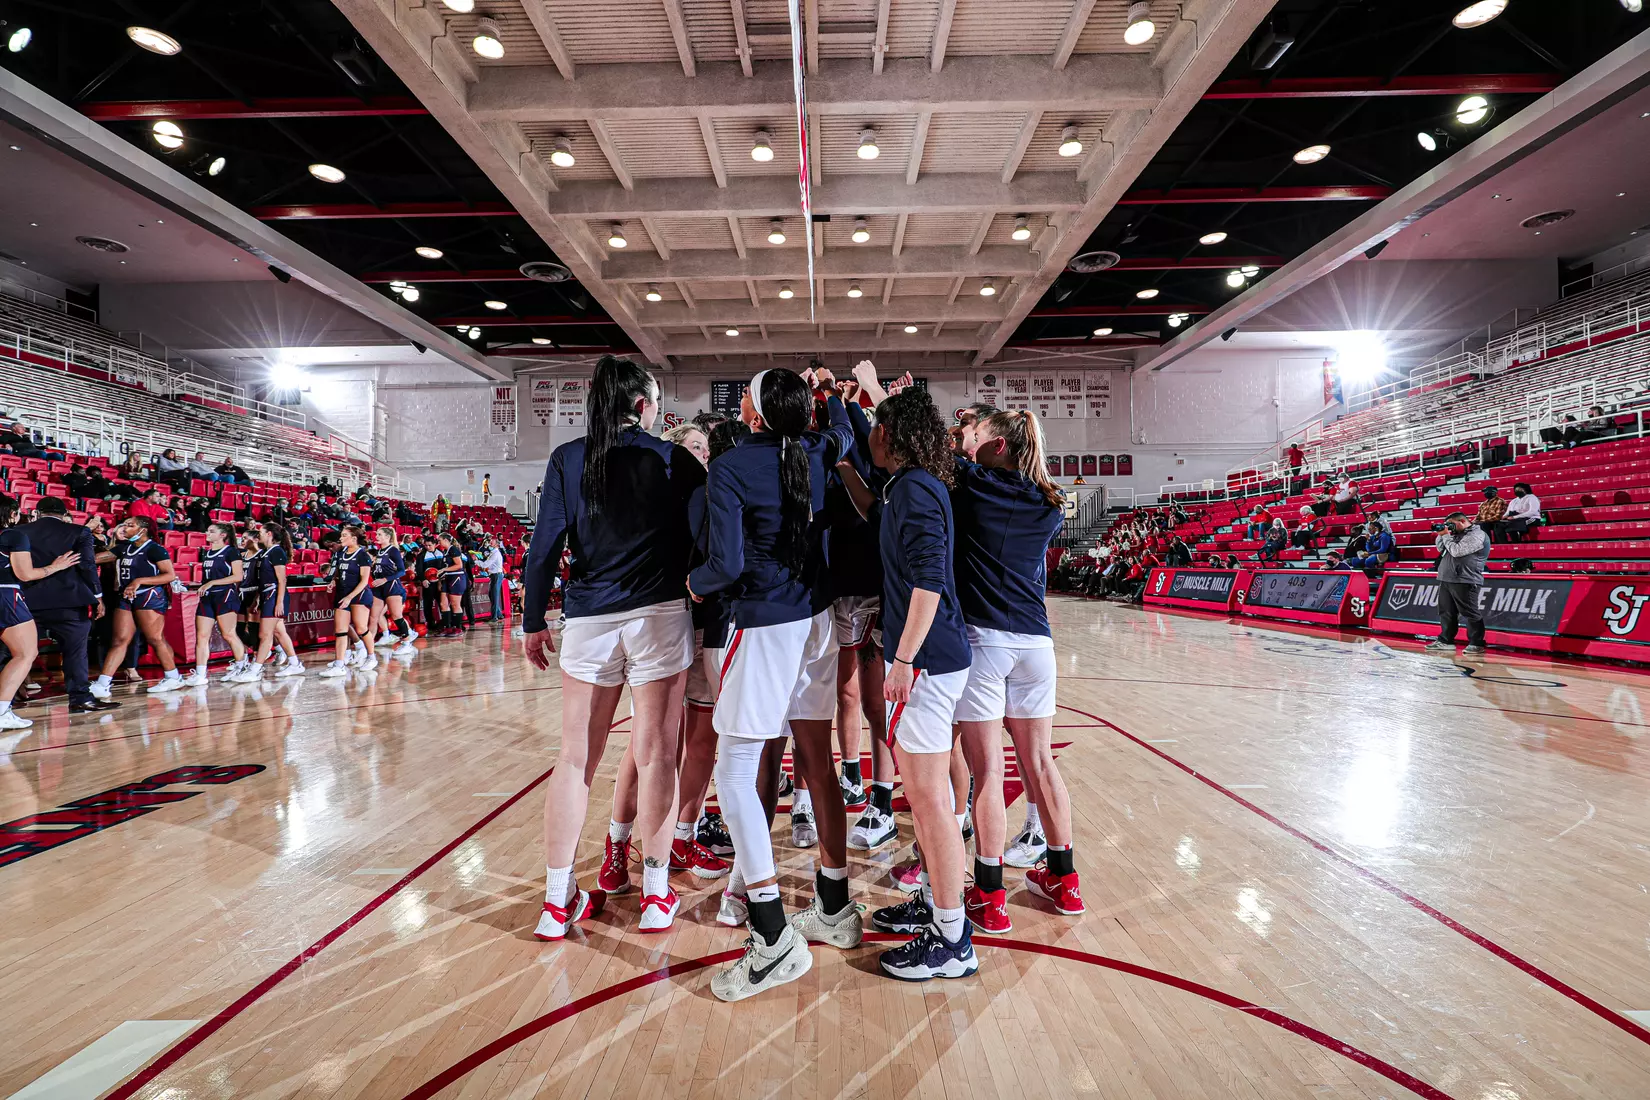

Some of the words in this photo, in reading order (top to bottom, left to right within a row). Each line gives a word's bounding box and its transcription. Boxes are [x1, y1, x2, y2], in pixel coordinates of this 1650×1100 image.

[1007, 379, 1026, 387] COACH
[496, 388, 511, 399] NIT
[121, 558, 133, 566] FDU
[121, 567, 131, 579] 23
[341, 570, 346, 581] 4
[1183, 576, 1212, 590] MUSCLE
[1210, 578, 1232, 591] MILK
[1270, 578, 1277, 589] 0
[1288, 576, 1307, 587] 40.8
[1316, 580, 1324, 591] 0
[1491, 588, 1553, 614] MILK
